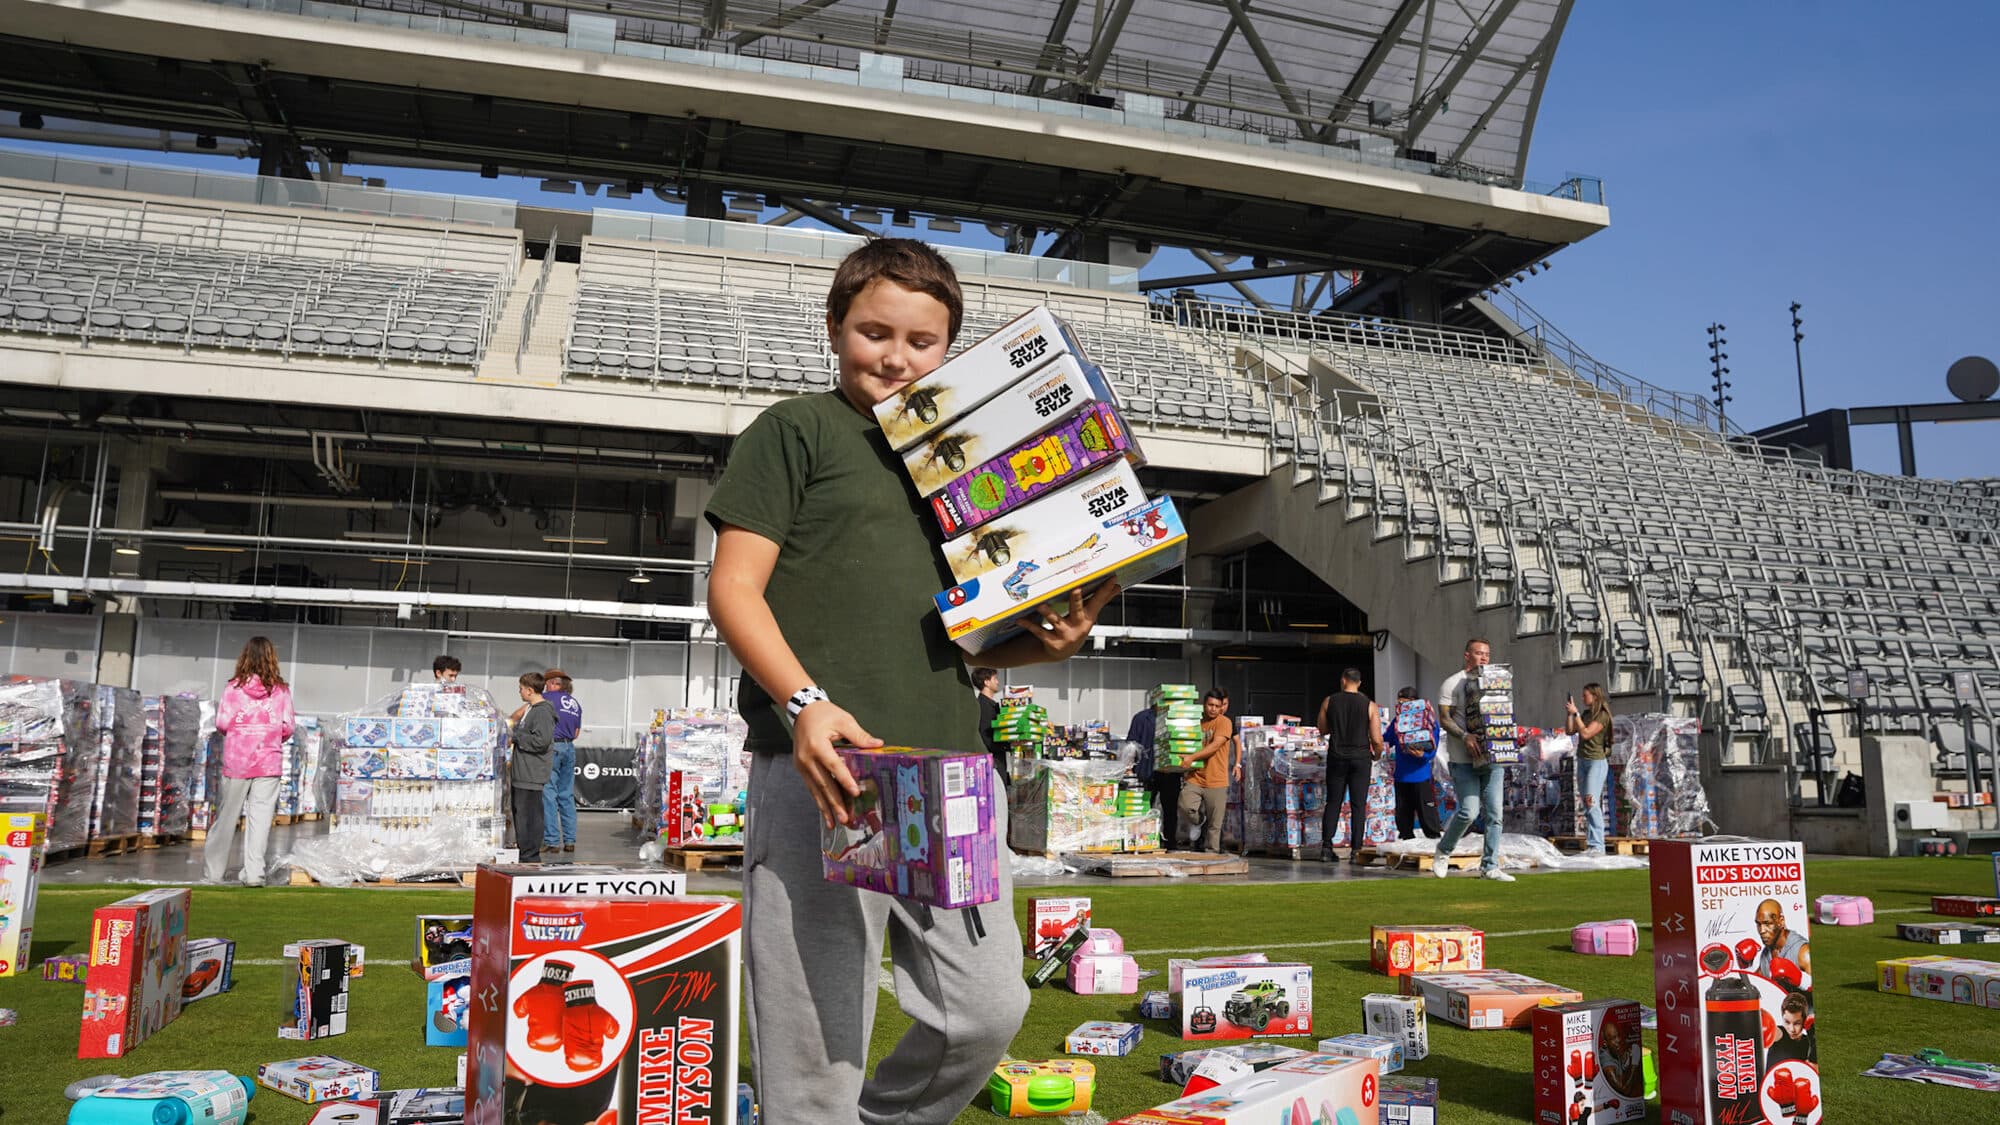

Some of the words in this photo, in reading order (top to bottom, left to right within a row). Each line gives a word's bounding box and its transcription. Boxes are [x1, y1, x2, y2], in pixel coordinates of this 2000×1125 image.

[1009, 334, 1047, 362] WARS
[1011, 341, 1048, 368] STAR
[1035, 383, 1072, 411] WARS
[1037, 390, 1073, 417] STAR
[1088, 486, 1127, 511] WARS
[1090, 494, 1129, 517] STAR
[601, 767, 638, 776] STADI
[13, 832, 27, 840] 28
[1700, 848, 1740, 862] MIKE
[1743, 846, 1796, 861] TYSON
[1700, 867, 1738, 881] KID'S
[1741, 866, 1799, 880] BOXING
[596, 880, 676, 895] TYSON
[1701, 886, 1771, 897] PUNCHING
[1774, 884, 1799, 895] BAG
[1701, 898, 1724, 910] SET
[1793, 903, 1803, 911] 6+
[522, 924, 584, 941] ALL-STAR
[538, 917, 568, 926] JUNIOR
[109, 920, 121, 965] MARKET
[1659, 882, 1678, 1053] TYSON
[1673, 912, 1690, 1026] MIKE
[1185, 976, 1209, 989] FORD
[1567, 1014, 1586, 1025] MIKE
[1567, 1024, 1593, 1036] TYSON
[674, 1016, 714, 1125] TYSON
[1540, 1025, 1549, 1096] TYSON
[1549, 1039, 1557, 1087] MIKE
[1715, 1033, 1737, 1100] TYSON
[1736, 1038, 1757, 1094] MIKE
[637, 1027, 675, 1125] MIKE
